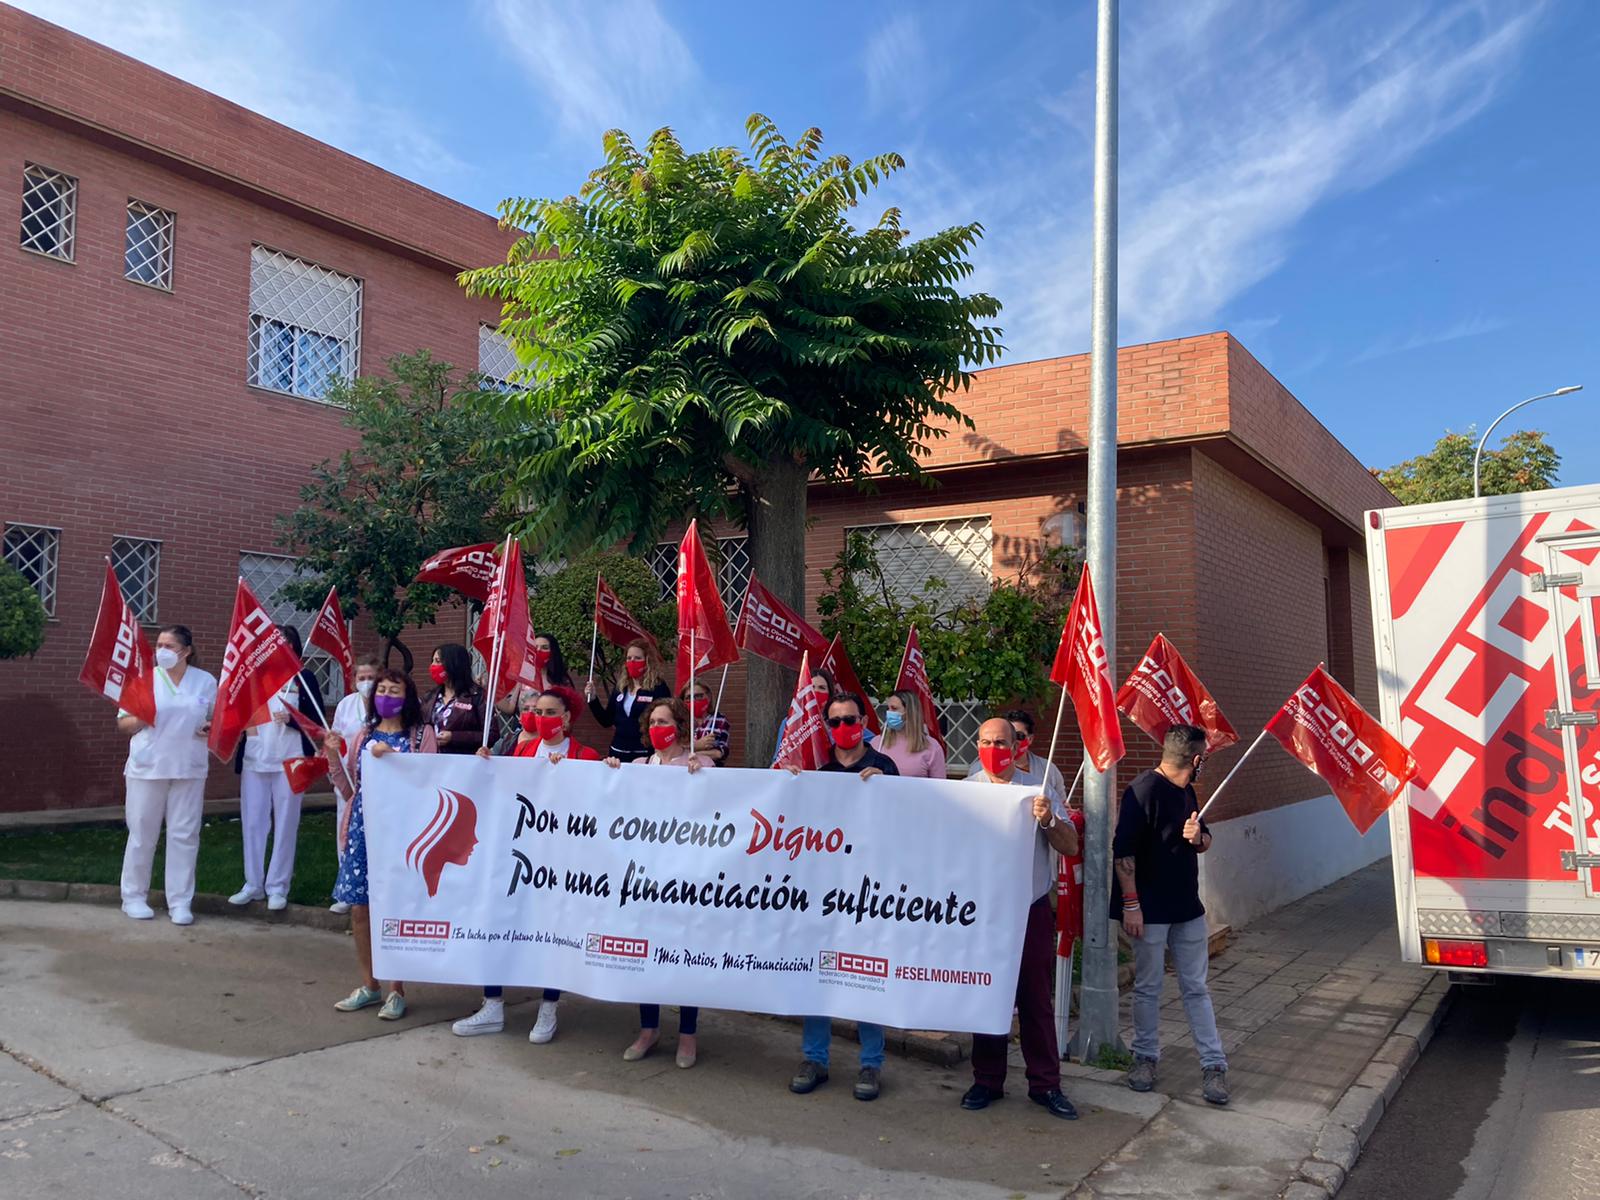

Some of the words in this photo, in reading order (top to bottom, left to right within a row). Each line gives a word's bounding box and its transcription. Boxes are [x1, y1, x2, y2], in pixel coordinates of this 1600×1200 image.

[746, 593, 801, 640] CCOO
[1283, 704, 1294, 716] de
[1293, 713, 1330, 750] Castilla-La
[1288, 699, 1327, 738] Comisiones
[1296, 684, 1374, 766] CCOO
[513, 793, 558, 840] Por
[566, 813, 598, 838] un
[608, 812, 736, 848] convenio
[745, 808, 853, 861] Digno.
[506, 848, 557, 898] Por
[564, 868, 611, 898] una
[619, 858, 809, 912] financiación
[822, 874, 977, 926] suficiente
[403, 922, 447, 936] CCOO
[467, 928, 486, 940] lucha
[488, 933, 501, 942] por
[502, 930, 510, 940] el
[511, 930, 534, 943] futuro
[535, 931, 543, 942] de
[544, 932, 551, 943] la
[603, 939, 645, 954] CCOO
[683, 949, 718, 969] Ratios,
[841, 956, 885, 974] CCOO
[895, 966, 992, 986] #ESELMOMENTO
